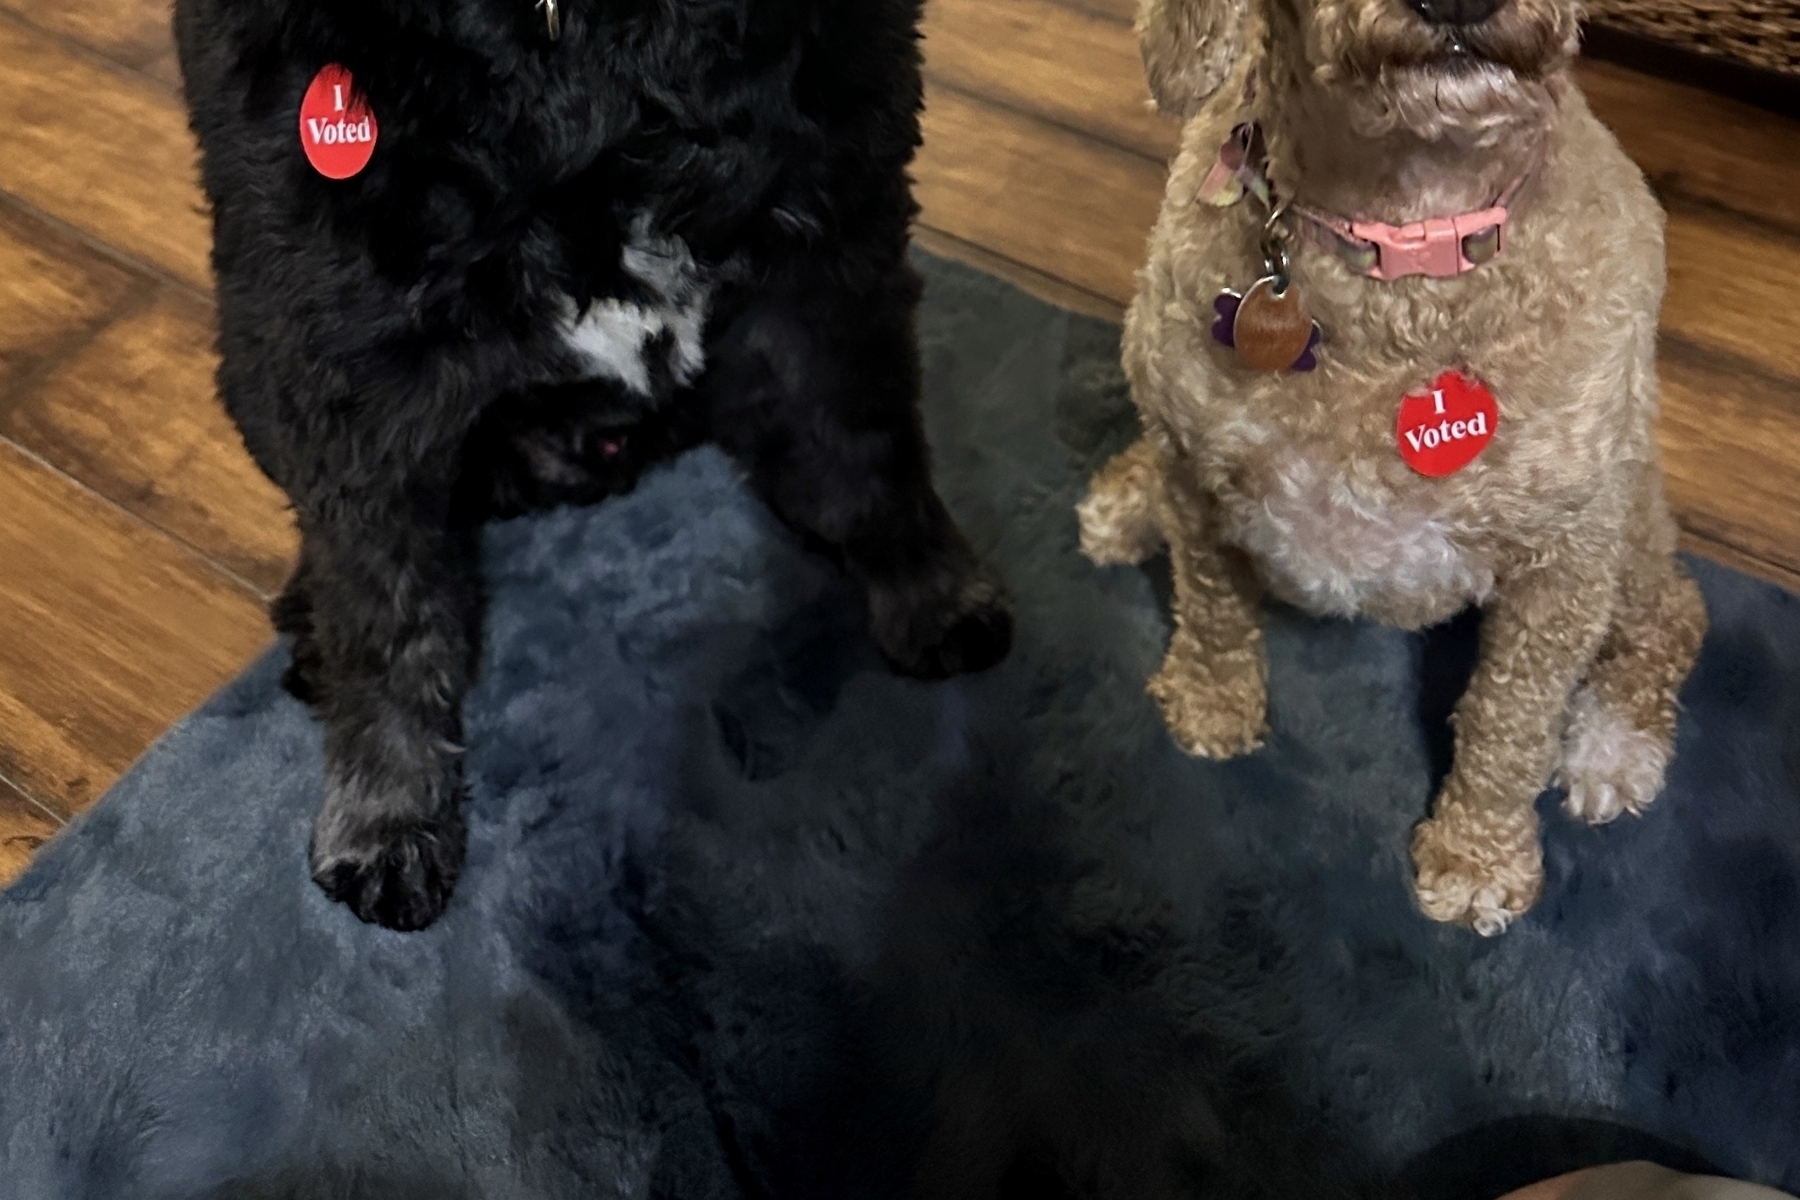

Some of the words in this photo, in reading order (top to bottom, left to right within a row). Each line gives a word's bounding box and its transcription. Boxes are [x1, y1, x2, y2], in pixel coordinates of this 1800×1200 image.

[334, 85, 344, 111] I
[307, 117, 371, 144] Voted
[1432, 389, 1446, 414] I
[1405, 412, 1487, 453] Voted
